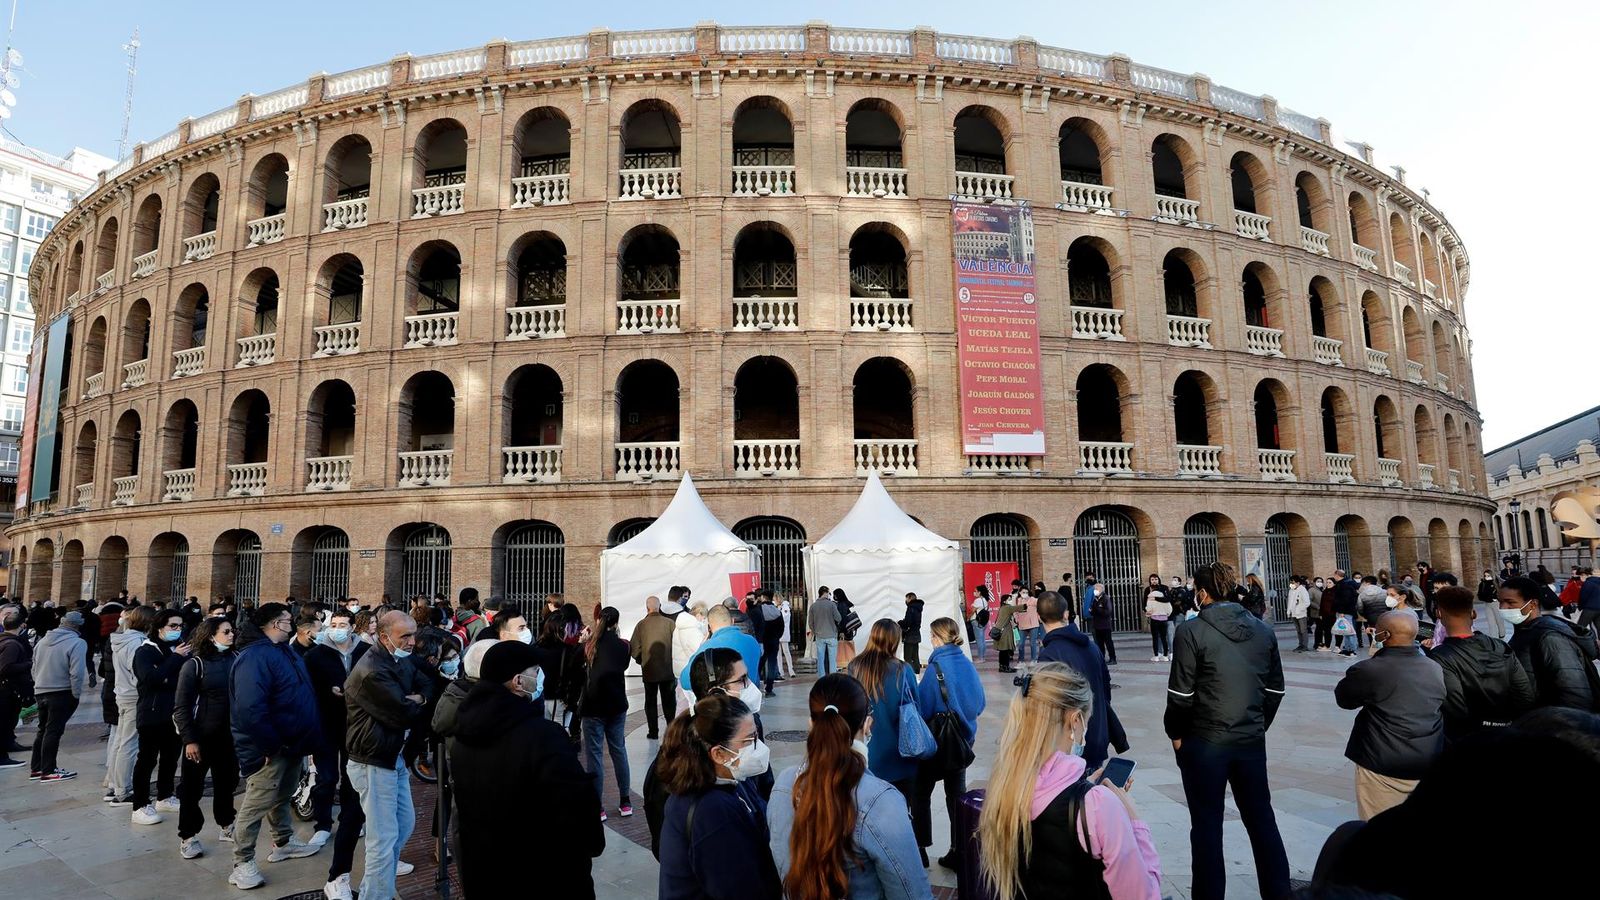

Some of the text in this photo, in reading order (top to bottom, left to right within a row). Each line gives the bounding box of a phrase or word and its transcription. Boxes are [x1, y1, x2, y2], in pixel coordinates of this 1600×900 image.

[958, 259, 1033, 275] VALENCIA
[961, 288, 968, 300] 5
[999, 316, 1036, 325] PUERTO
[969, 329, 1031, 339] UCEDA LEAL
[966, 344, 1033, 354] MATÍAS TEJELA
[964, 360, 1036, 370] OCTAVIO CHACÓN
[976, 375, 1028, 384] PEPE MORAL
[968, 390, 1035, 400] JOAQUÍN GALDÓS
[973, 406, 1032, 416] JESÚS CHOVER
